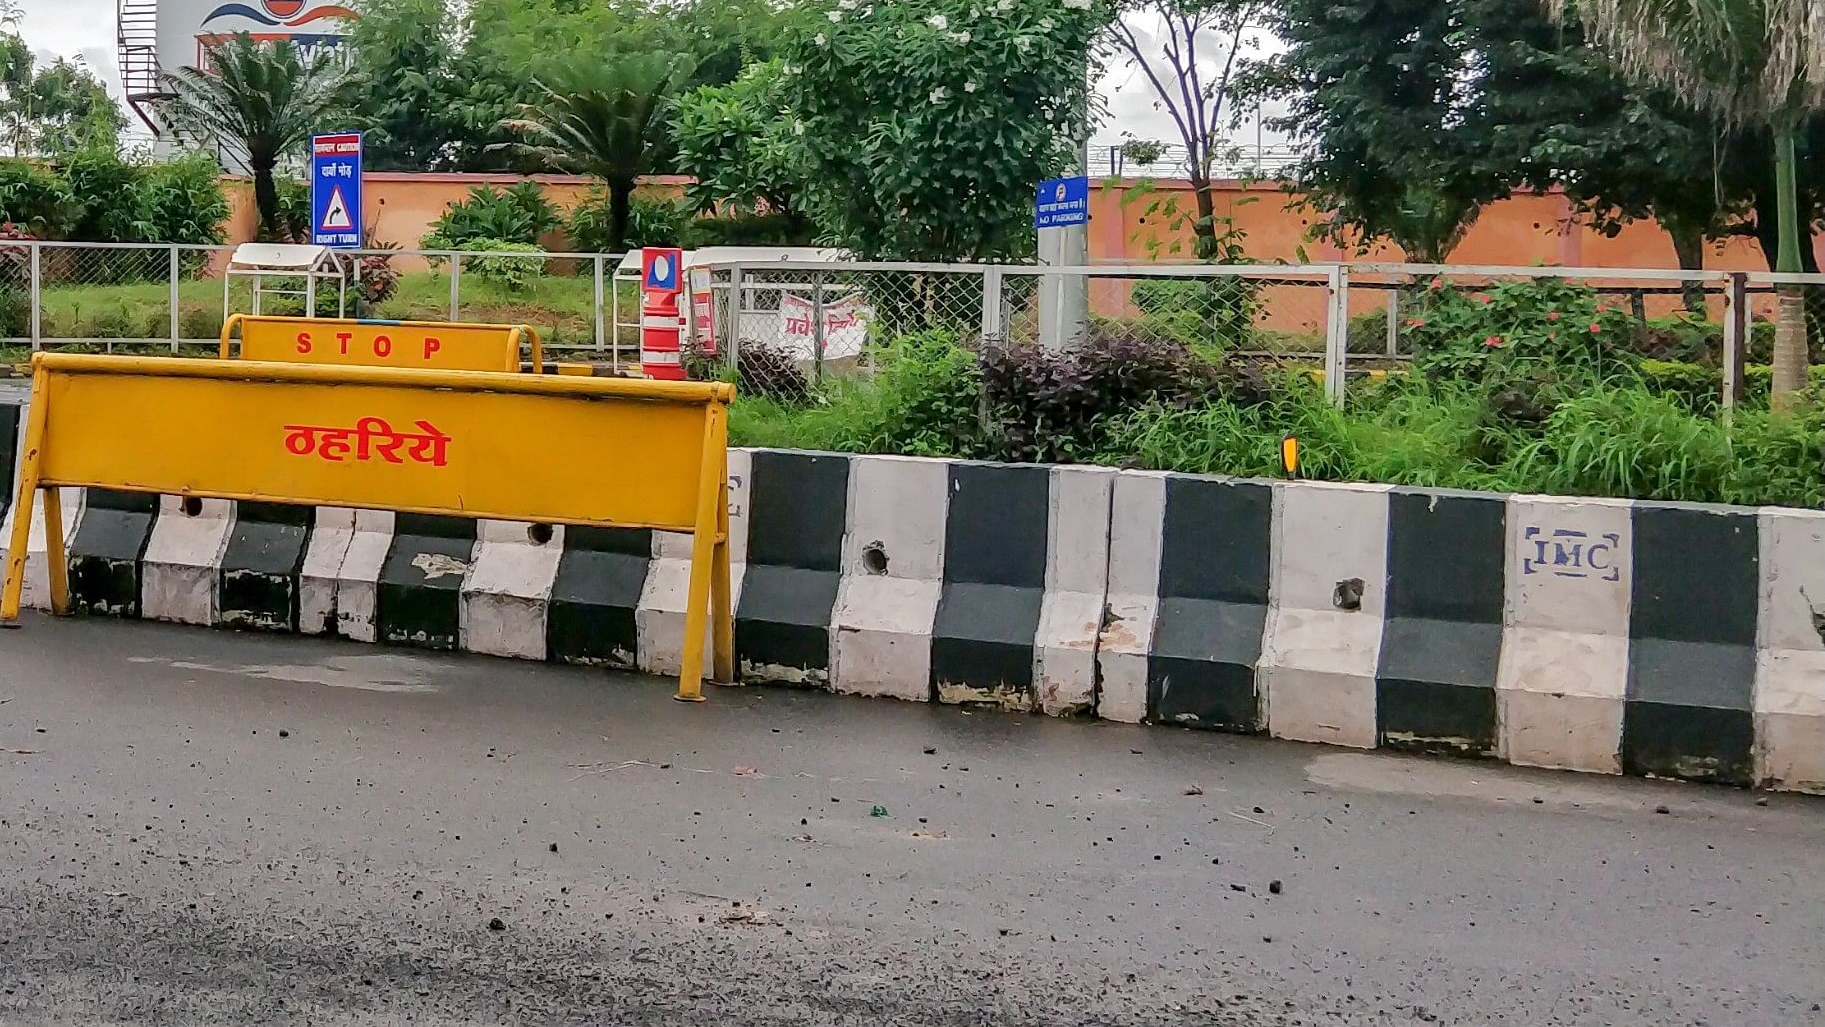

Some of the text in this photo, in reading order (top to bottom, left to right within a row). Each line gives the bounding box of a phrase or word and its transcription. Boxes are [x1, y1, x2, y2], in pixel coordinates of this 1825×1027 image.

[1040, 212, 1084, 224] NO PARKING
[316, 234, 357, 244] RIGHT TURN
[295, 330, 442, 360] STOP
[284, 416, 453, 467] ठहरिये
[1534, 540, 1609, 570] IMC
